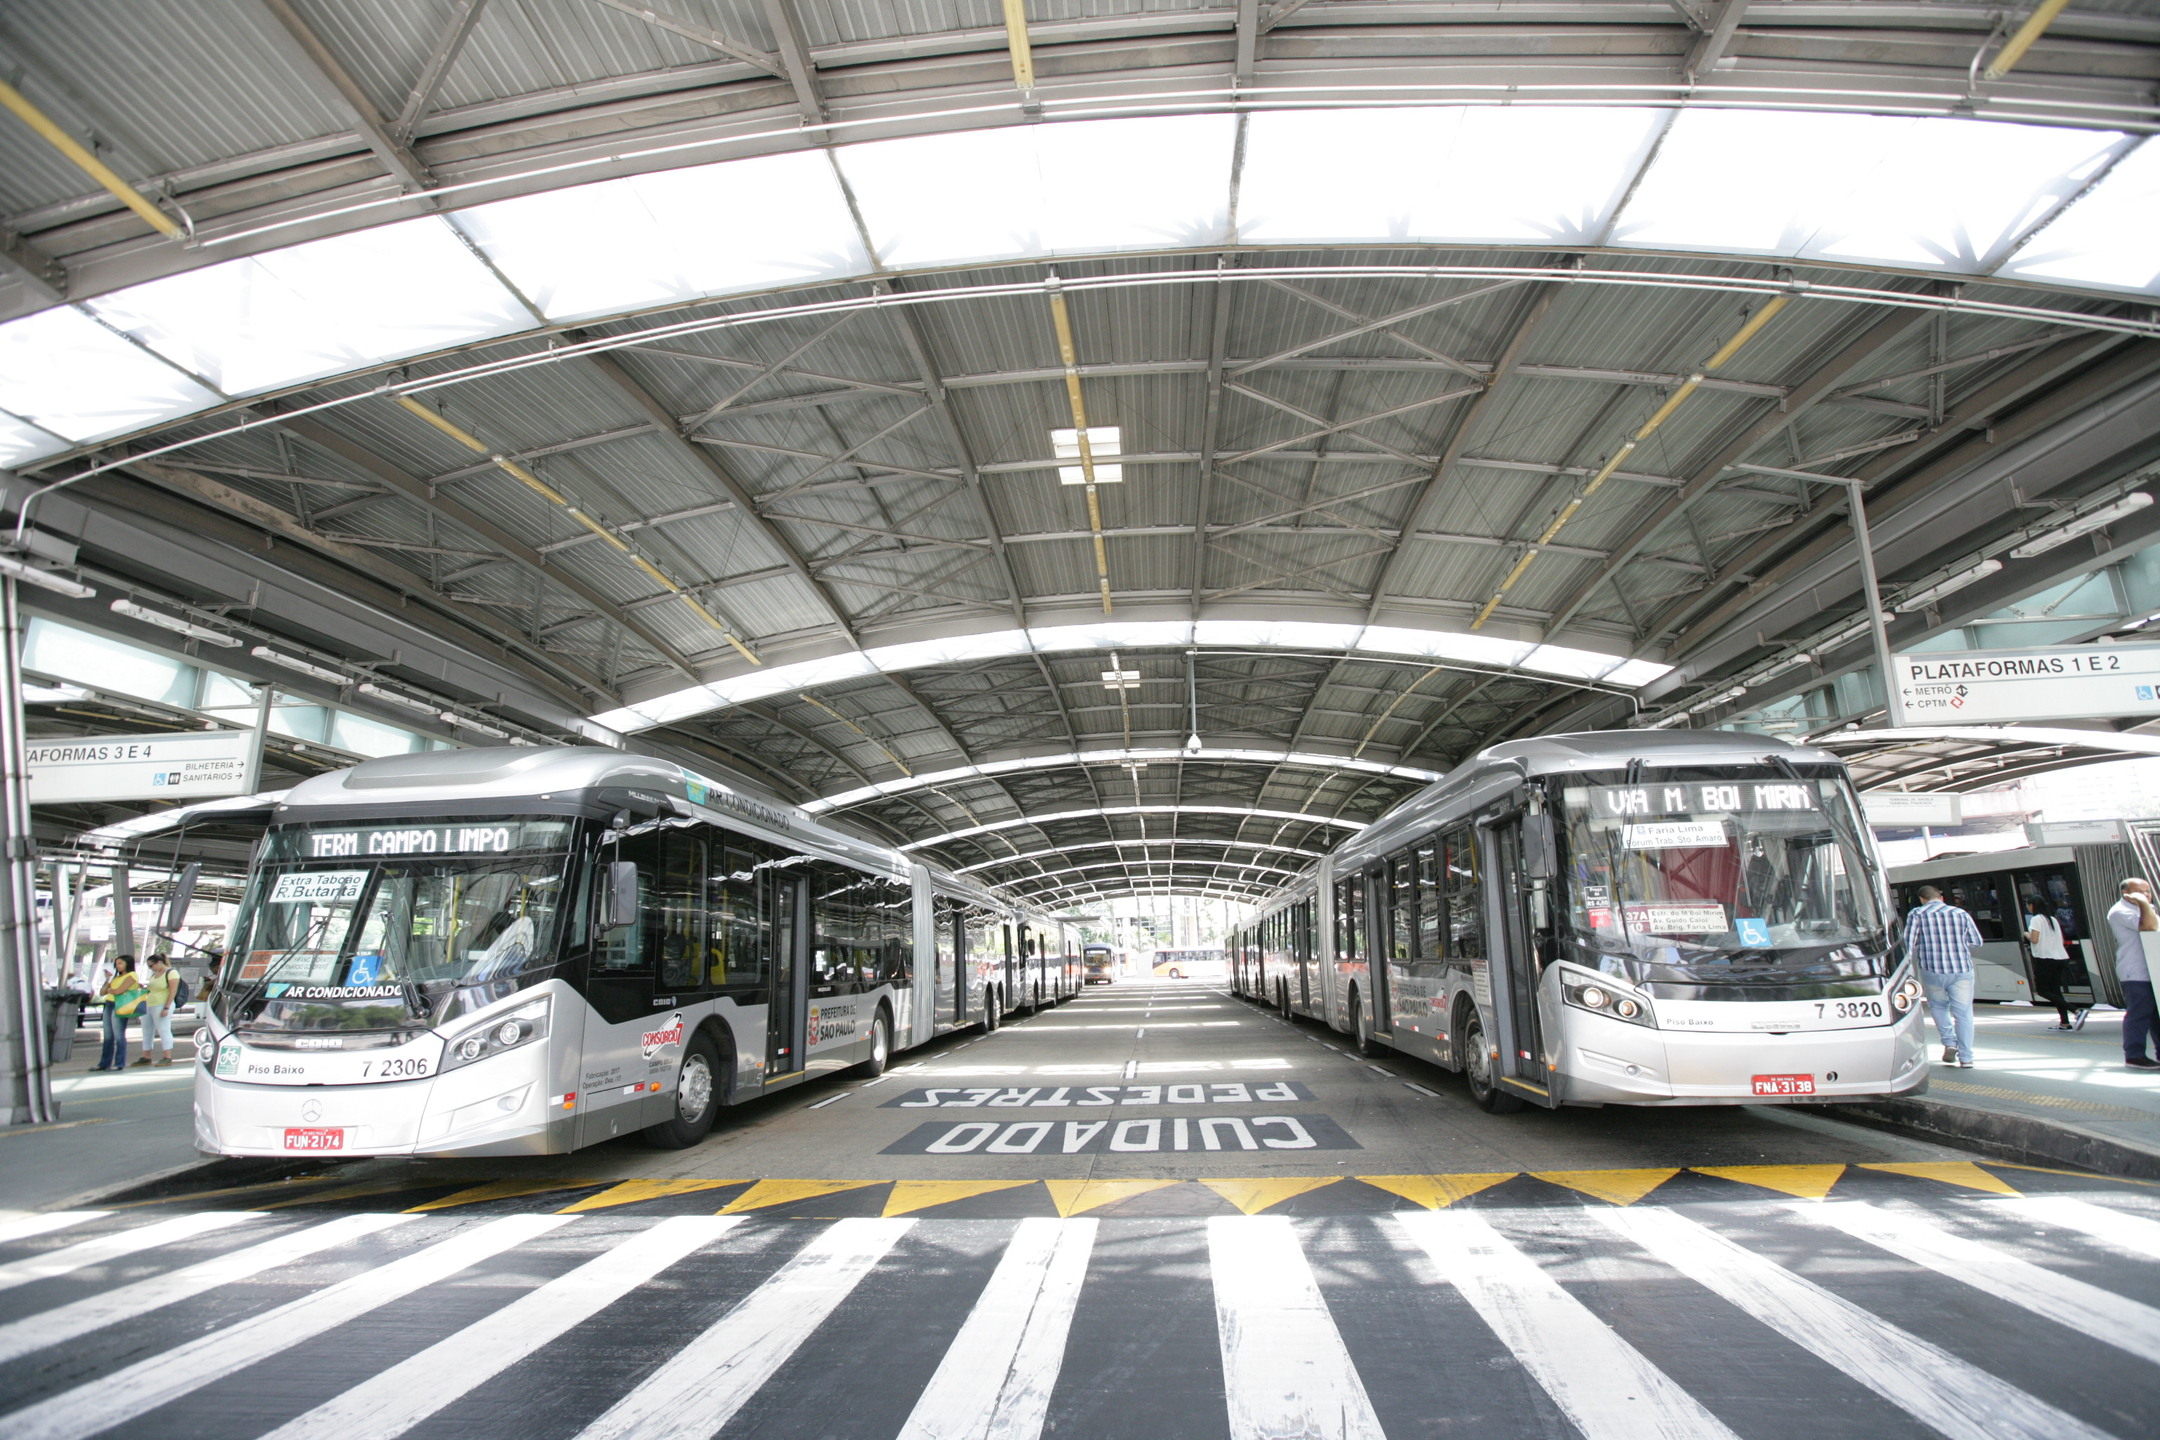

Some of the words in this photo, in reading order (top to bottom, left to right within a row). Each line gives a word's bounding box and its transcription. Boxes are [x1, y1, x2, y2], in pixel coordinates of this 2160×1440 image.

[1911, 658, 2064, 681] PLATAFORMAS
[2072, 658, 2081, 671] 1
[2089, 656, 2103, 671] E
[2108, 655, 2121, 670] 2
[1917, 699, 1947, 709] CPTM
[27, 746, 109, 763] AFORMAS
[114, 746, 123, 759] 3
[128, 746, 139, 759] E
[143, 745, 152, 758] 4
[185, 761, 234, 771] BILHETERIA
[182, 771, 233, 783] SANITÁRIOS
[1607, 789, 1649, 815] VIA
[1701, 785, 1741, 811] BOI
[1754, 784, 1811, 809] MIRIM
[709, 788, 723, 805] AR
[726, 793, 789, 830] CONDICIONADO
[1648, 826, 1675, 835] Faria
[1678, 824, 1704, 833] Lima
[369, 830, 436, 855] CAMPO
[444, 827, 509, 853] LIMPO
[1696, 834, 1723, 843] Amaro
[281, 875, 312, 886] Extra
[317, 873, 362, 885] Taboão
[286, 986, 303, 998] AR
[305, 985, 402, 998] CONDICIONADO
[820, 1005, 849, 1020] PREFEITURA
[1814, 1003, 1825, 1019] 7
[1837, 1001, 1883, 1018] 3820
[1666, 1017, 1686, 1026] Piso
[1688, 1018, 1714, 1026] Baixo
[820, 1020, 835, 1041] SÃO
[835, 1020, 856, 1038] PAULO
[248, 1065, 270, 1075] Piso
[273, 1063, 305, 1075] Baixo
[362, 1061, 374, 1078] 7
[380, 1058, 428, 1077] 2306
[899, 1082, 1300, 1108] PEDESTRES
[925, 1116, 1317, 1154] CUIDADO
